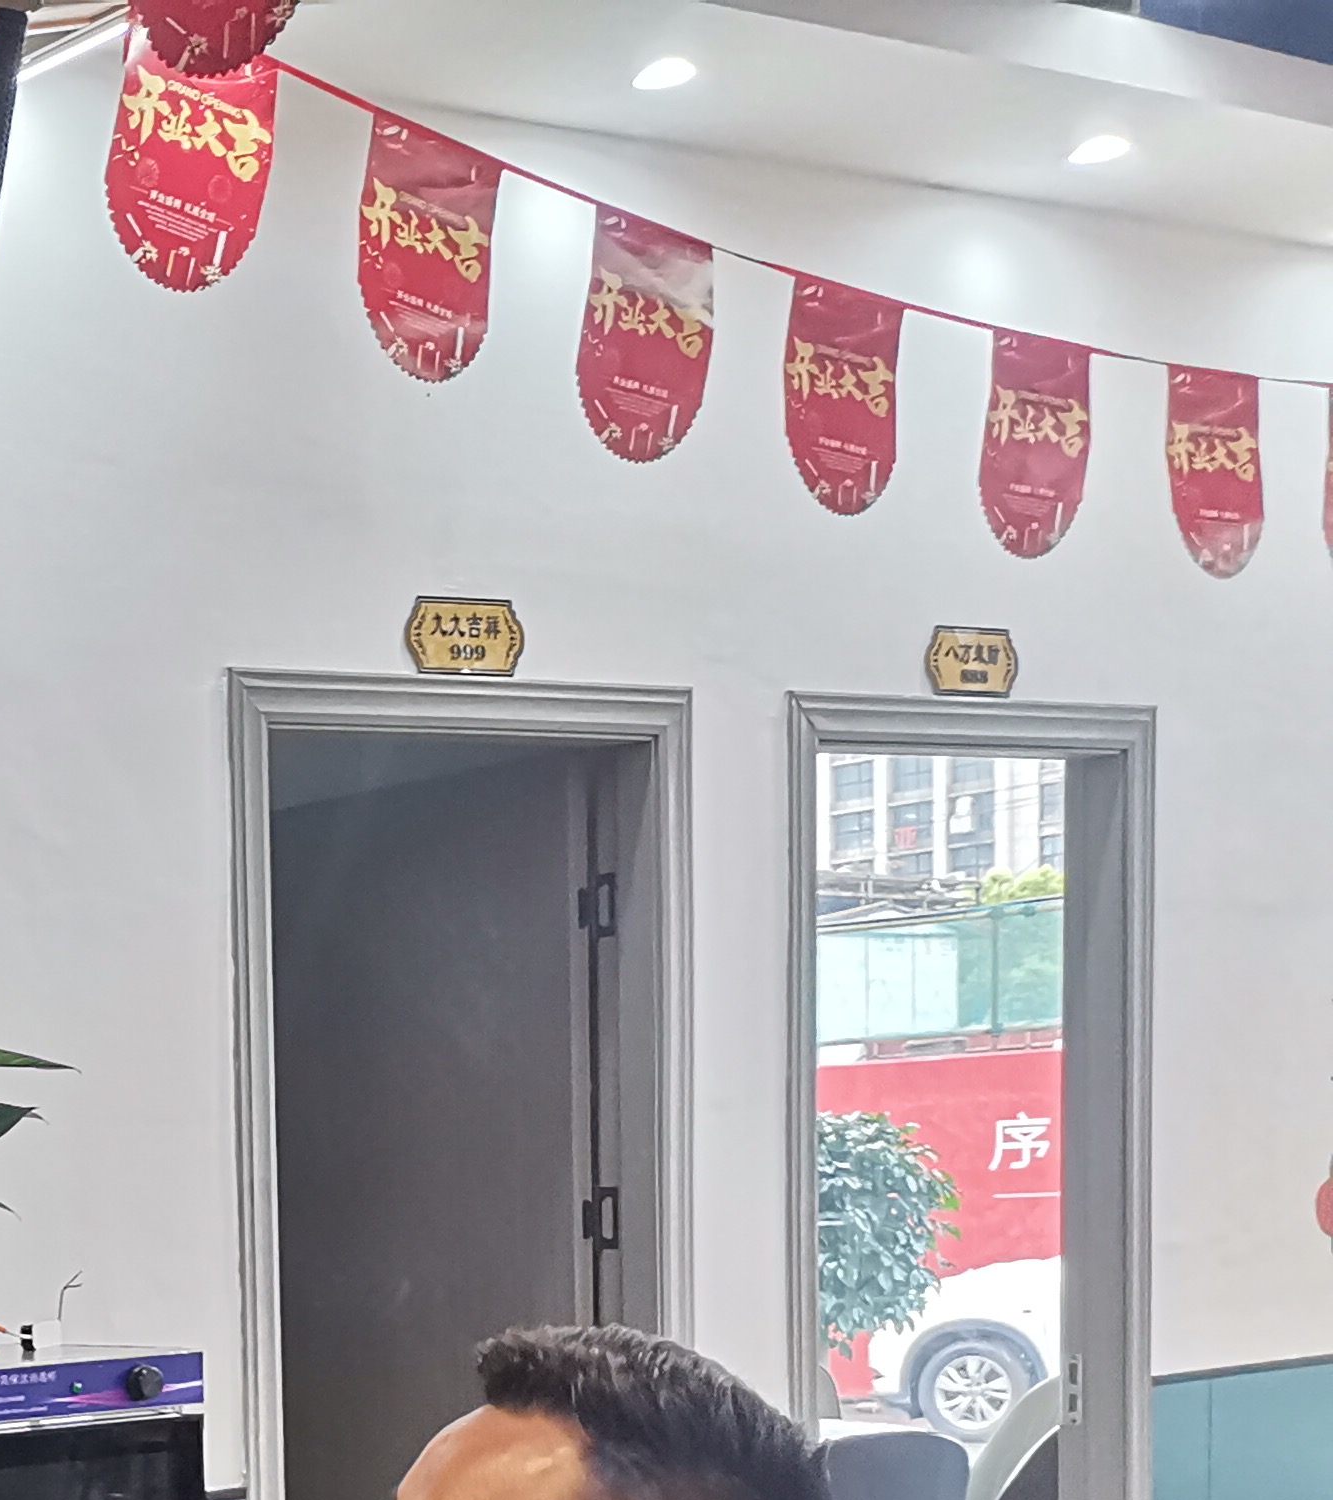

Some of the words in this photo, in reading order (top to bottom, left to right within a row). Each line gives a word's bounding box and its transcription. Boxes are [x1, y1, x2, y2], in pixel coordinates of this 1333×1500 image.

[122, 65, 272, 182] 开业大吉
[361, 177, 489, 283] 开业大吉
[589, 266, 713, 359] 开业大吉
[785, 336, 894, 417] 开业大吉
[989, 385, 1088, 458] 开业大吉
[1167, 421, 1258, 482] 开业大吉
[429, 611, 502, 640] 九九吉祥
[449, 643, 486, 660] 999
[987, 1111, 1051, 1171] 序
